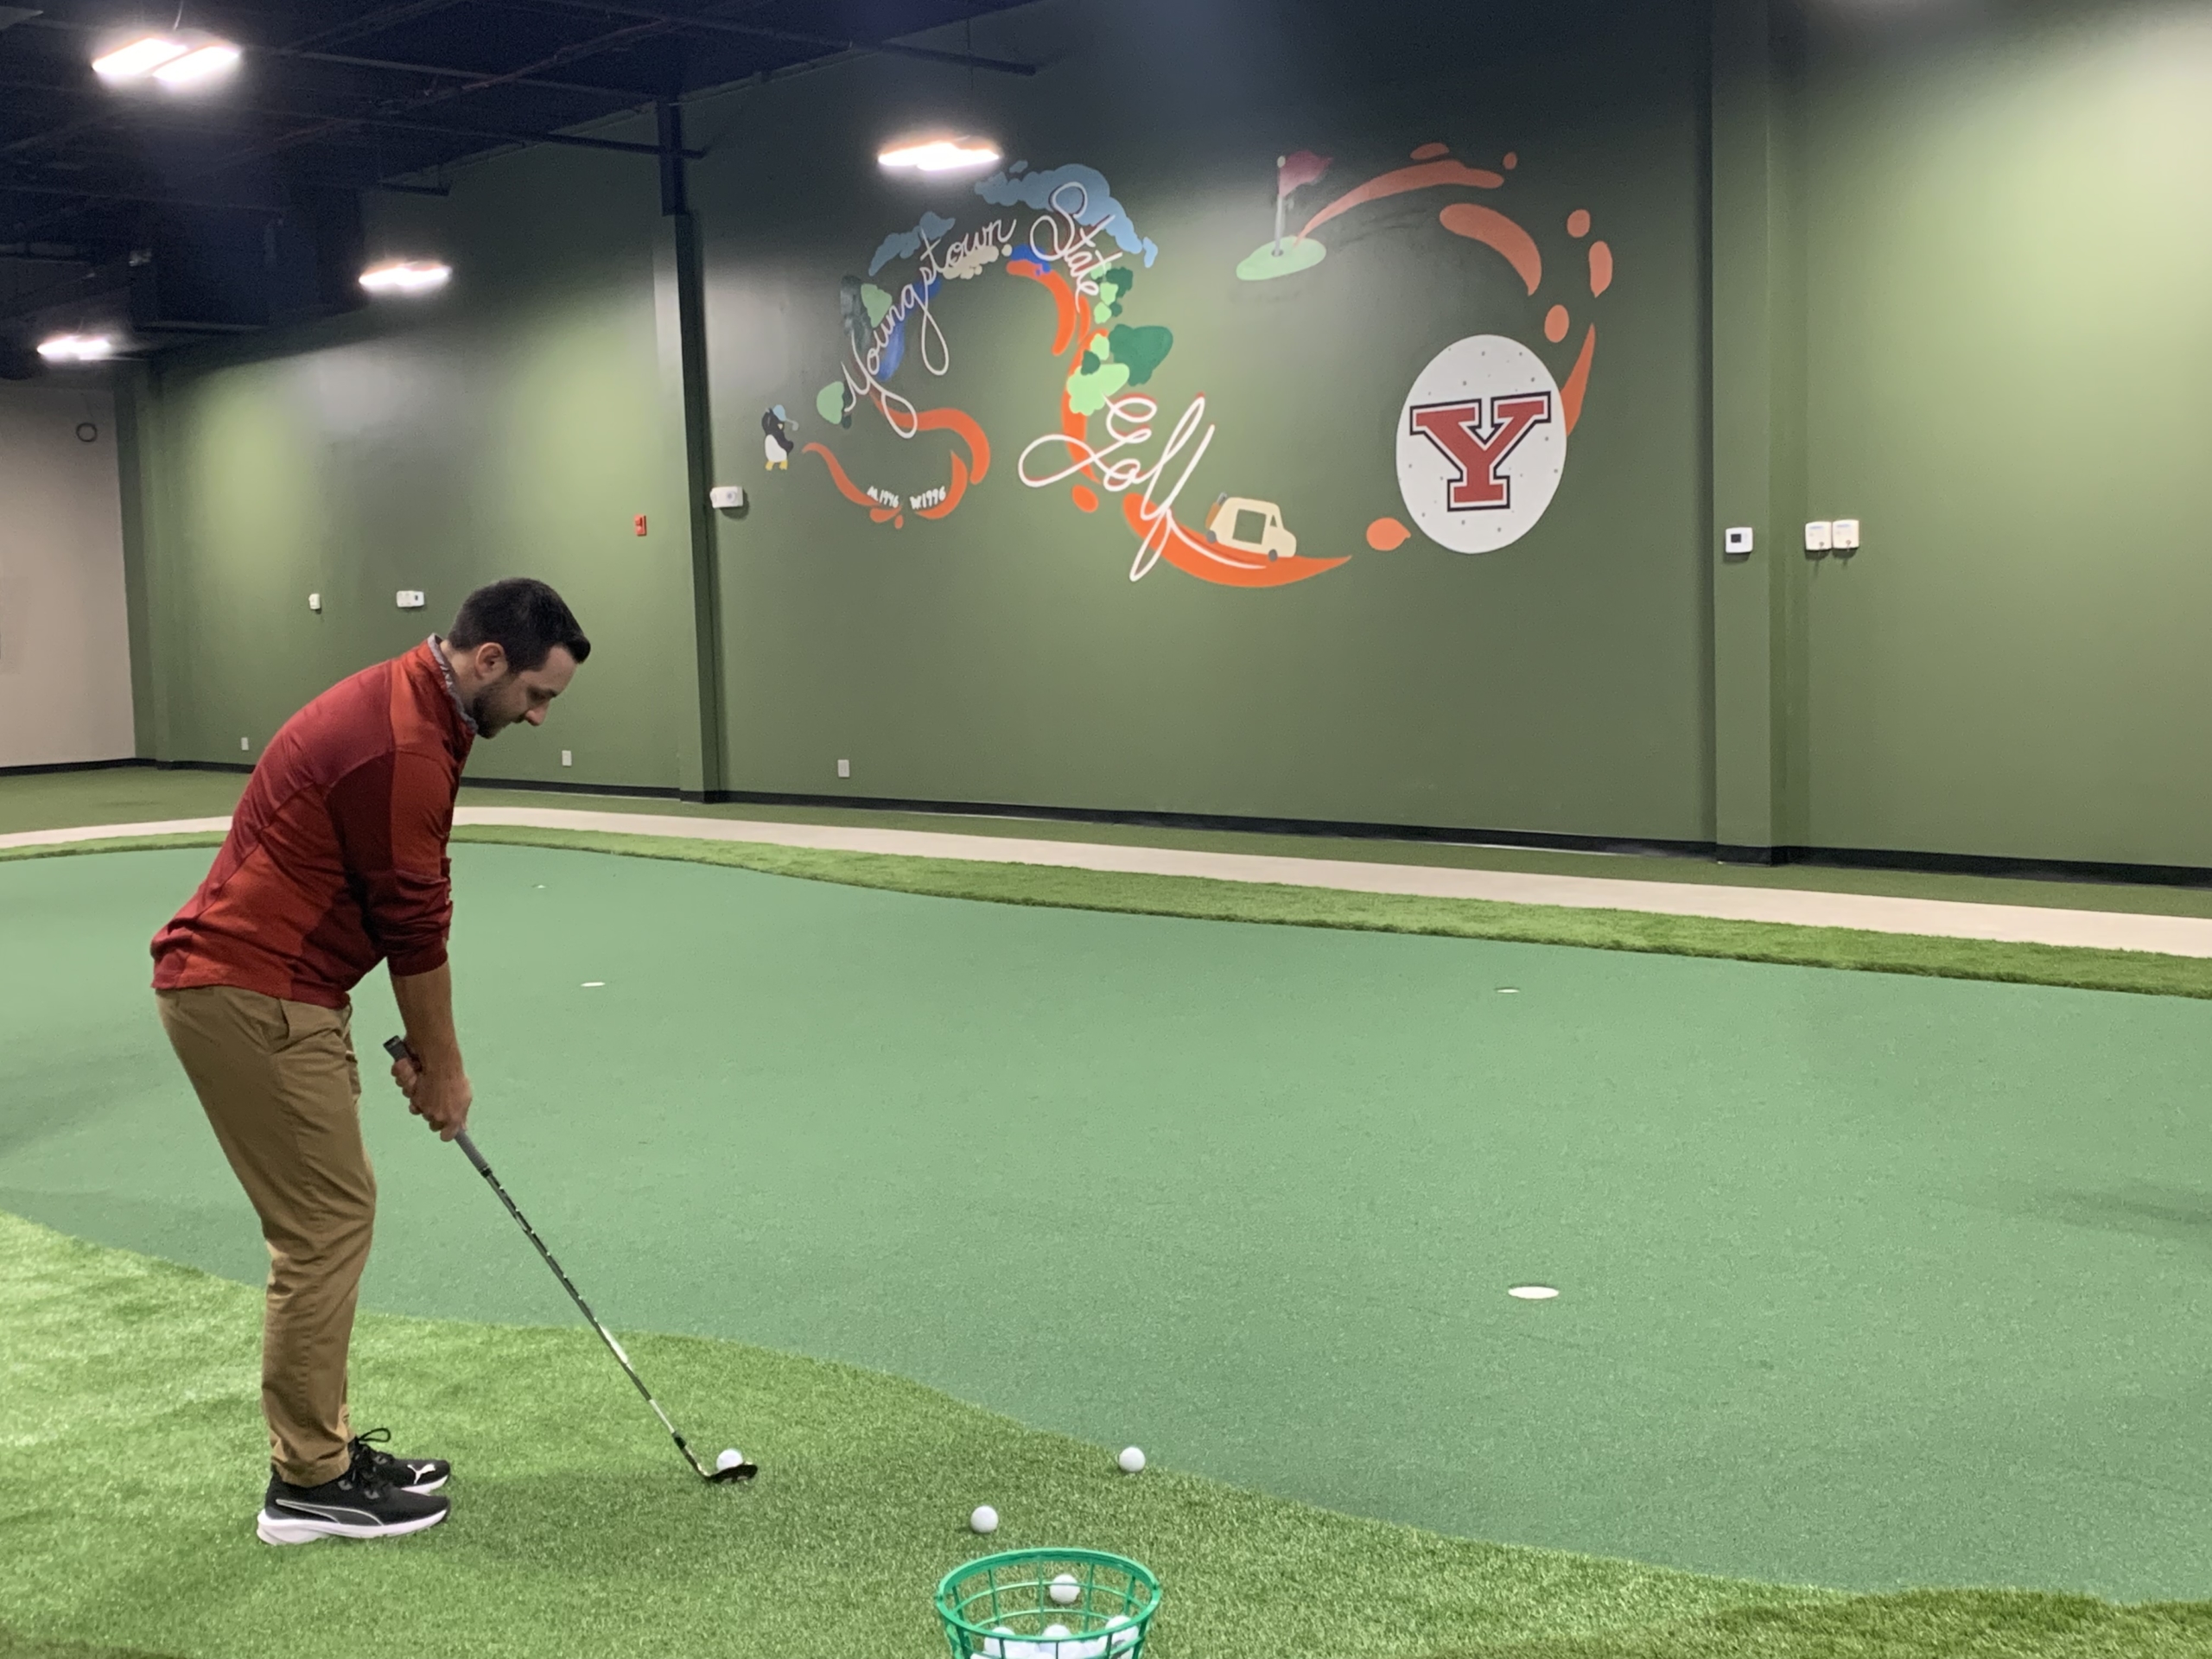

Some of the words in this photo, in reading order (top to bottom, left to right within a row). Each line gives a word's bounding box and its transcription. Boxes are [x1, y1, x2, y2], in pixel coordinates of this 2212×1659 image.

[841, 218, 1017, 439] Youngstown
[1029, 181, 1123, 314] State
[1409, 391, 1552, 512] Y
